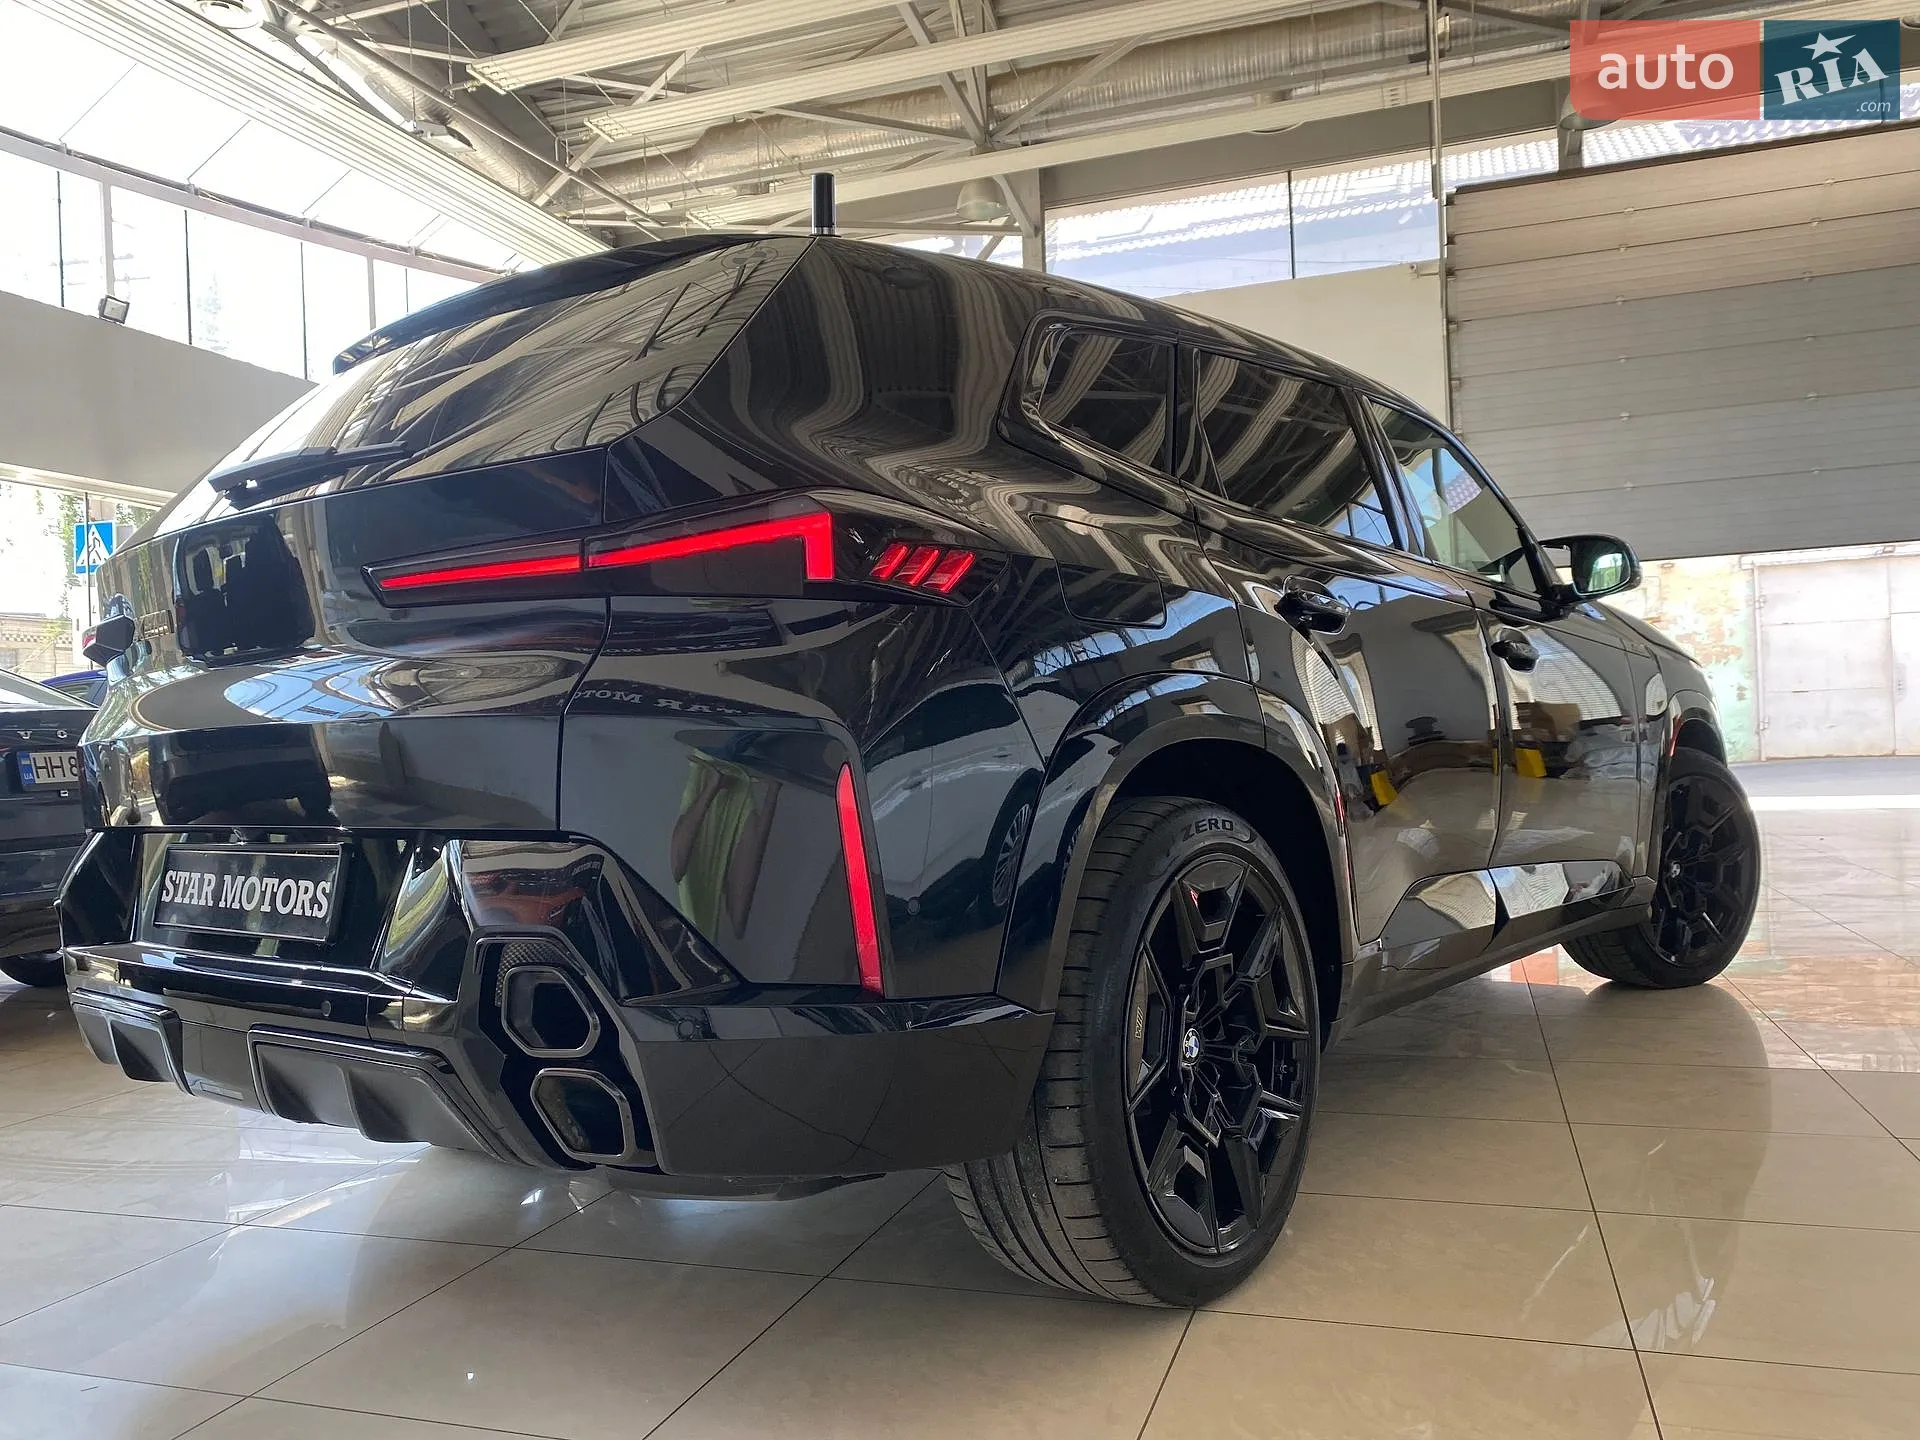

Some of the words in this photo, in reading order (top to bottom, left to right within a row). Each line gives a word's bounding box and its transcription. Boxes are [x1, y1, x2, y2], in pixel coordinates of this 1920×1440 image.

[1181, 818, 1234, 841] ZERO
[161, 870, 216, 907] STAR
[218, 874, 331, 919] MOTORS
